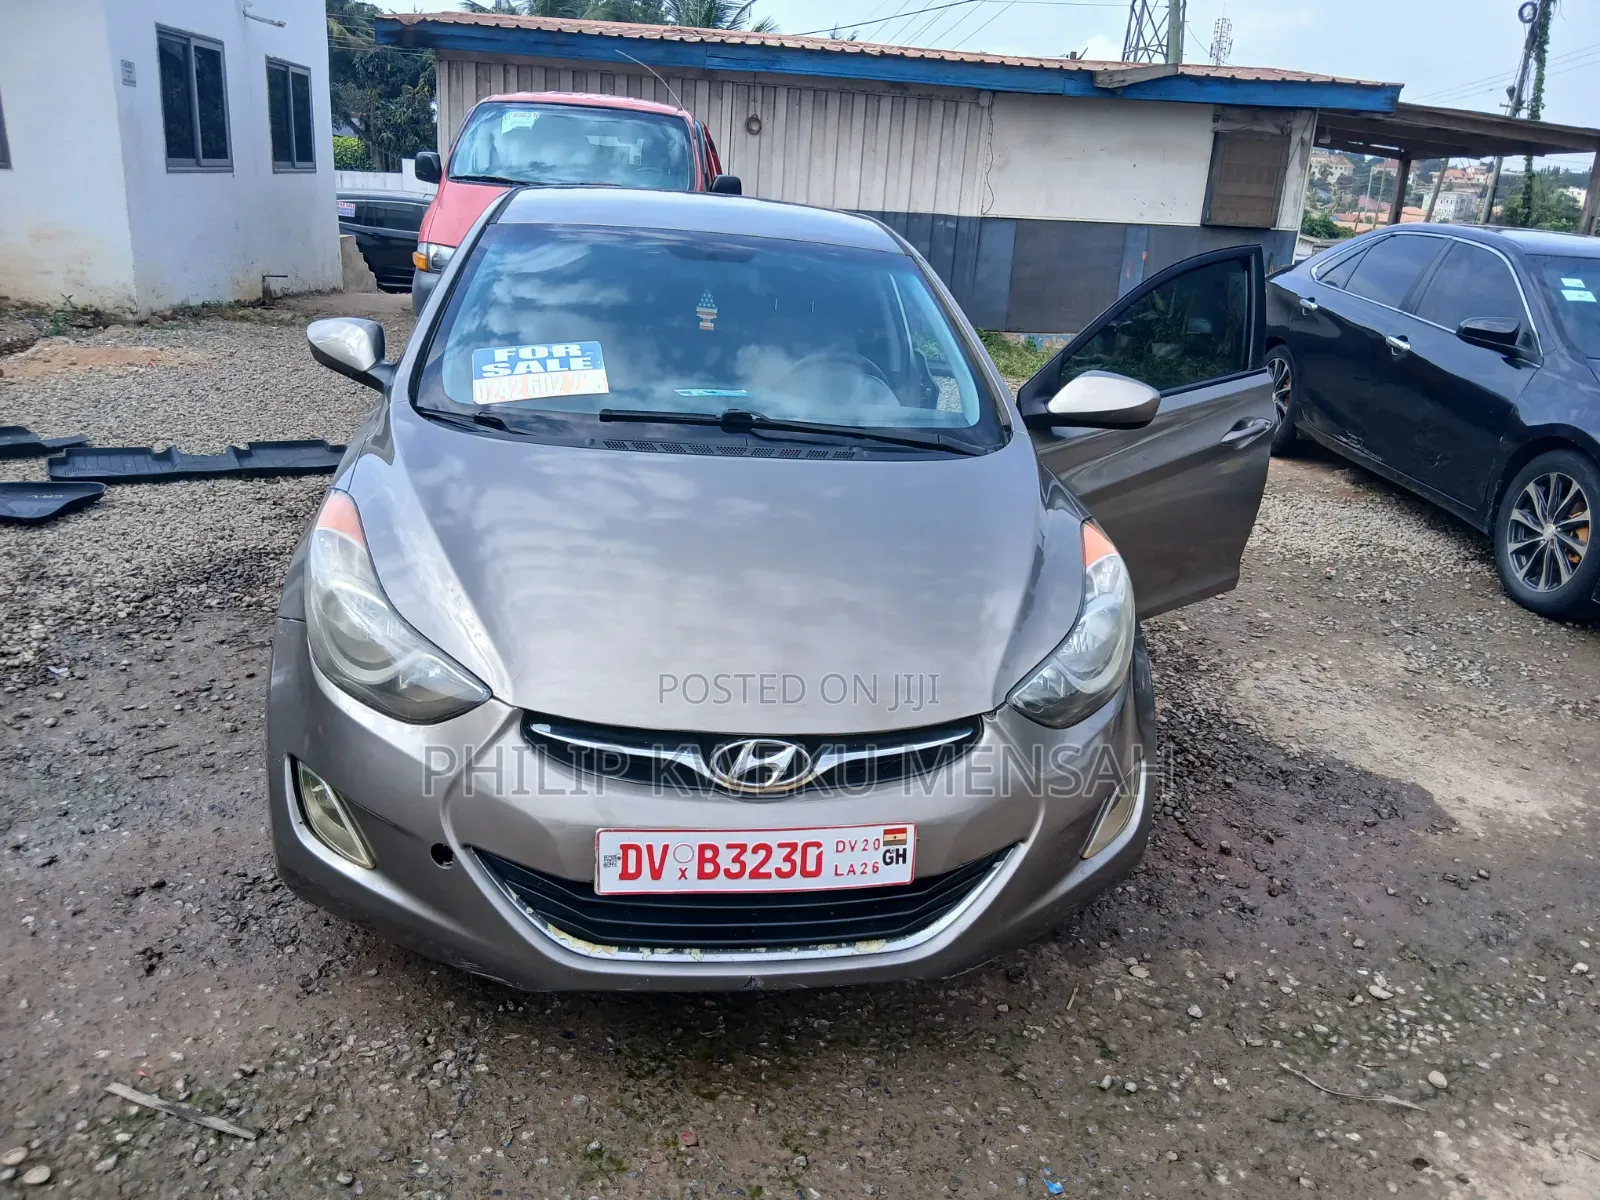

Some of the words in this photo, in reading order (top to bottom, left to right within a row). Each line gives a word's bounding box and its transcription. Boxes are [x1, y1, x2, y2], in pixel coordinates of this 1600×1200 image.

[494, 344, 582, 362] FOR
[482, 356, 594, 378] SALE
[835, 838, 881, 853] DV20
[618, 842, 670, 881] DV
[696, 840, 823, 881] B3230
[882, 847, 907, 867] GH
[834, 861, 880, 877] LA26
